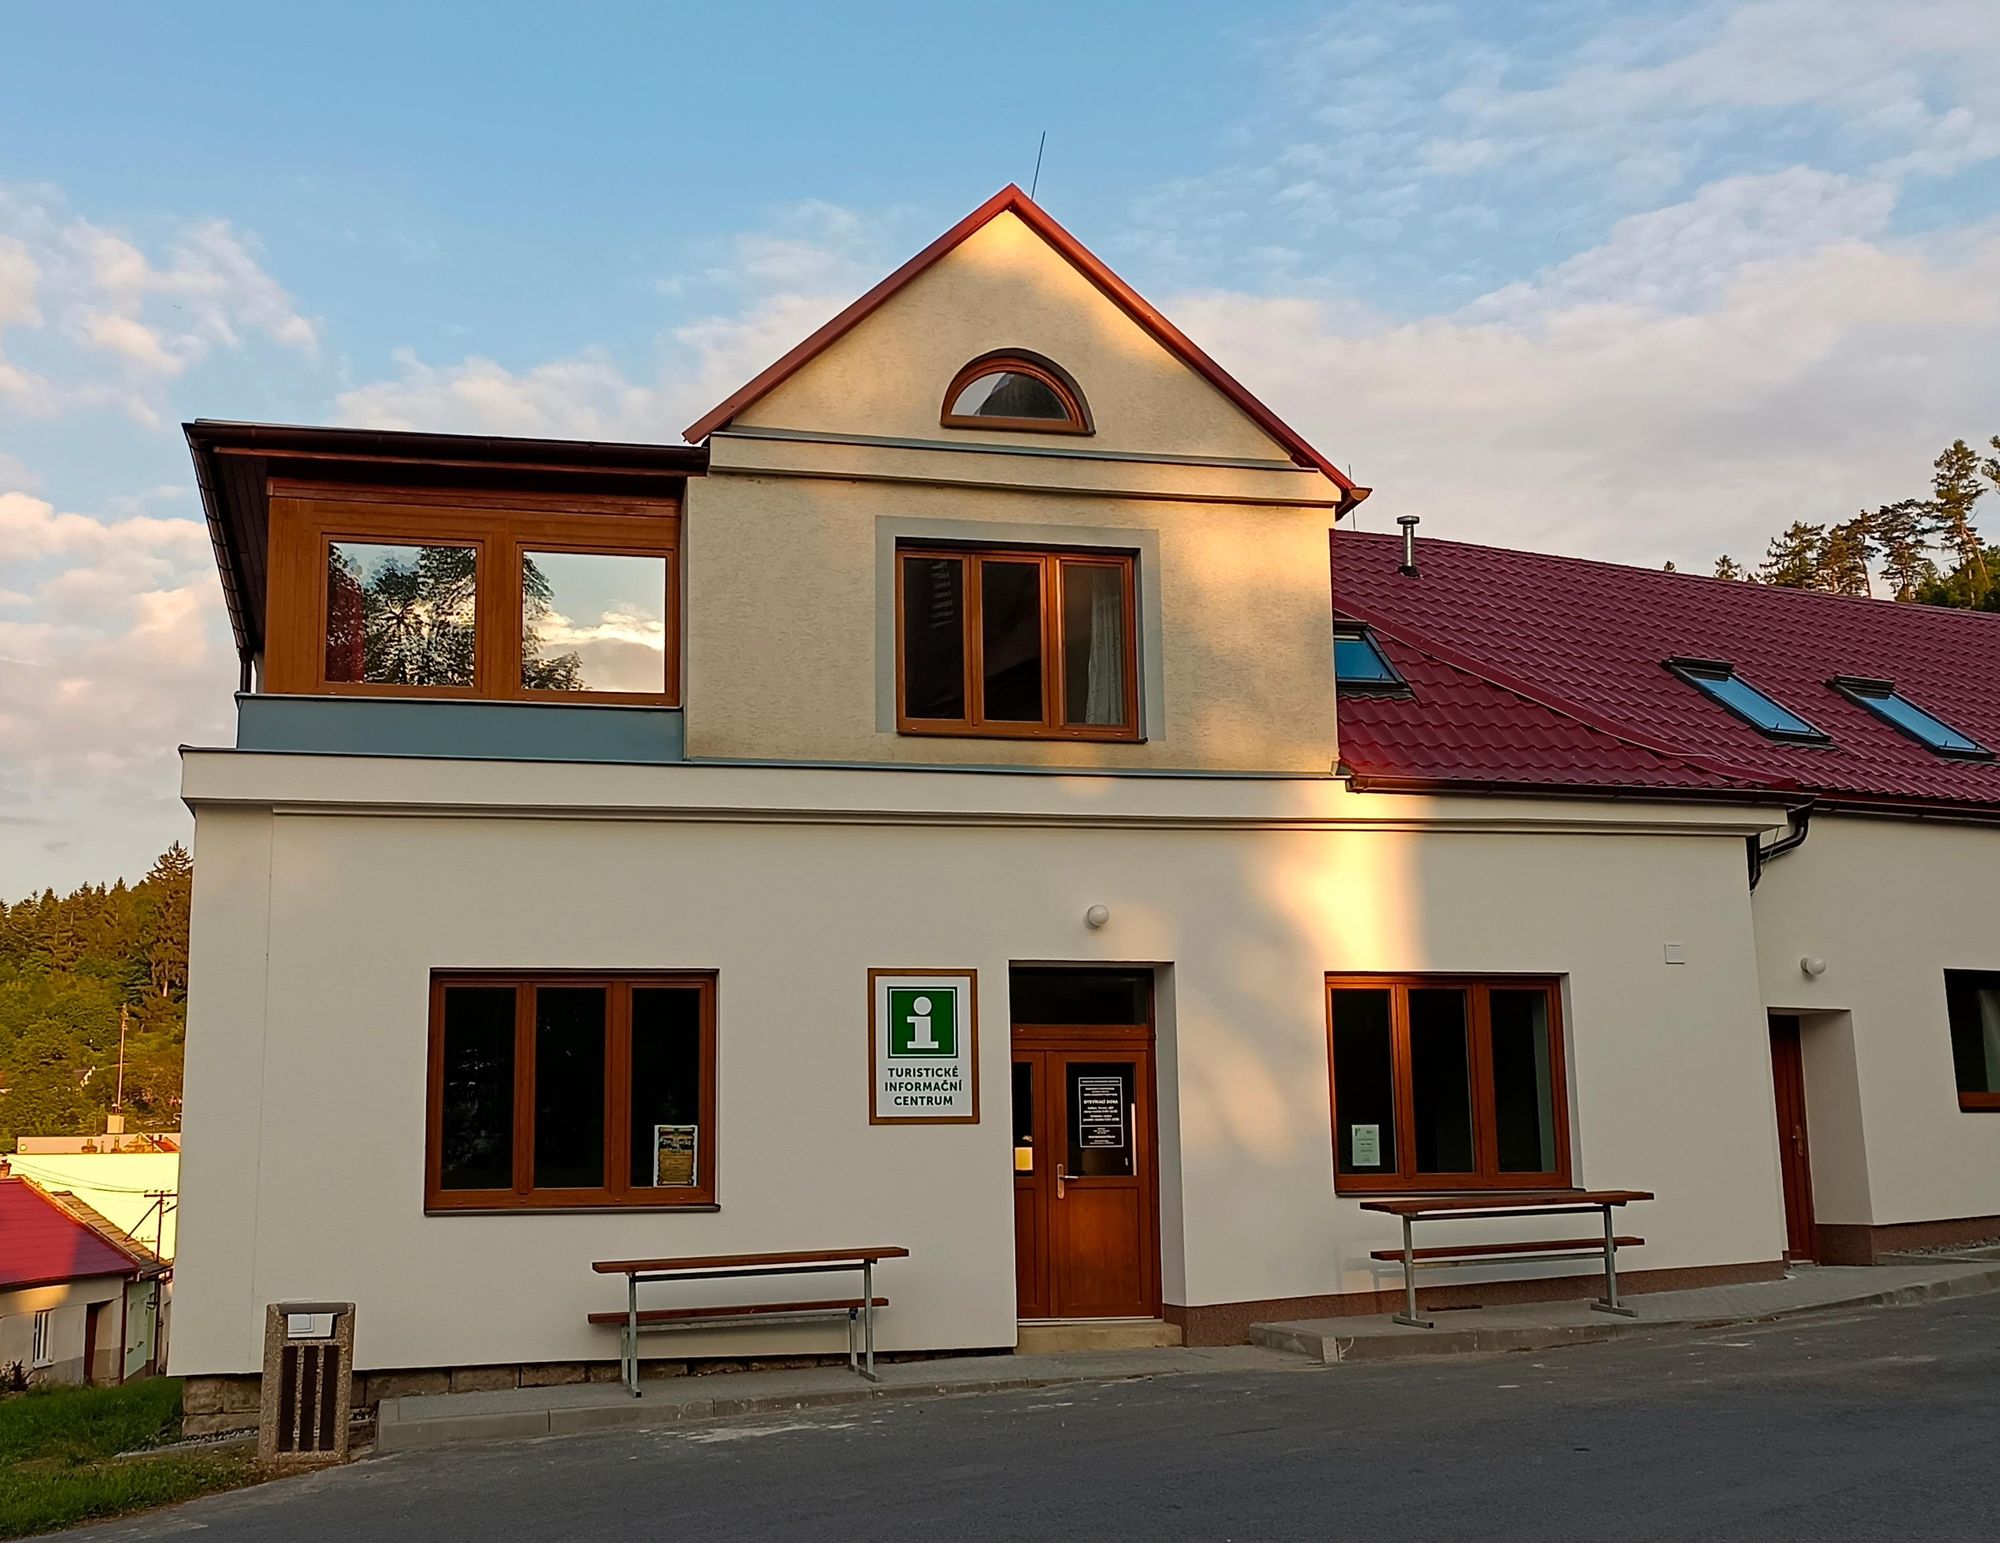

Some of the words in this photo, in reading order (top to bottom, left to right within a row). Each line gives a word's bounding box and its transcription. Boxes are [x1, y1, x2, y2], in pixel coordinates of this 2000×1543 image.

[888, 1066, 959, 1077] TURISTICKÉ
[884, 1080, 962, 1092] INFORMAČNÍ
[894, 1096, 953, 1106] CENTRUM
